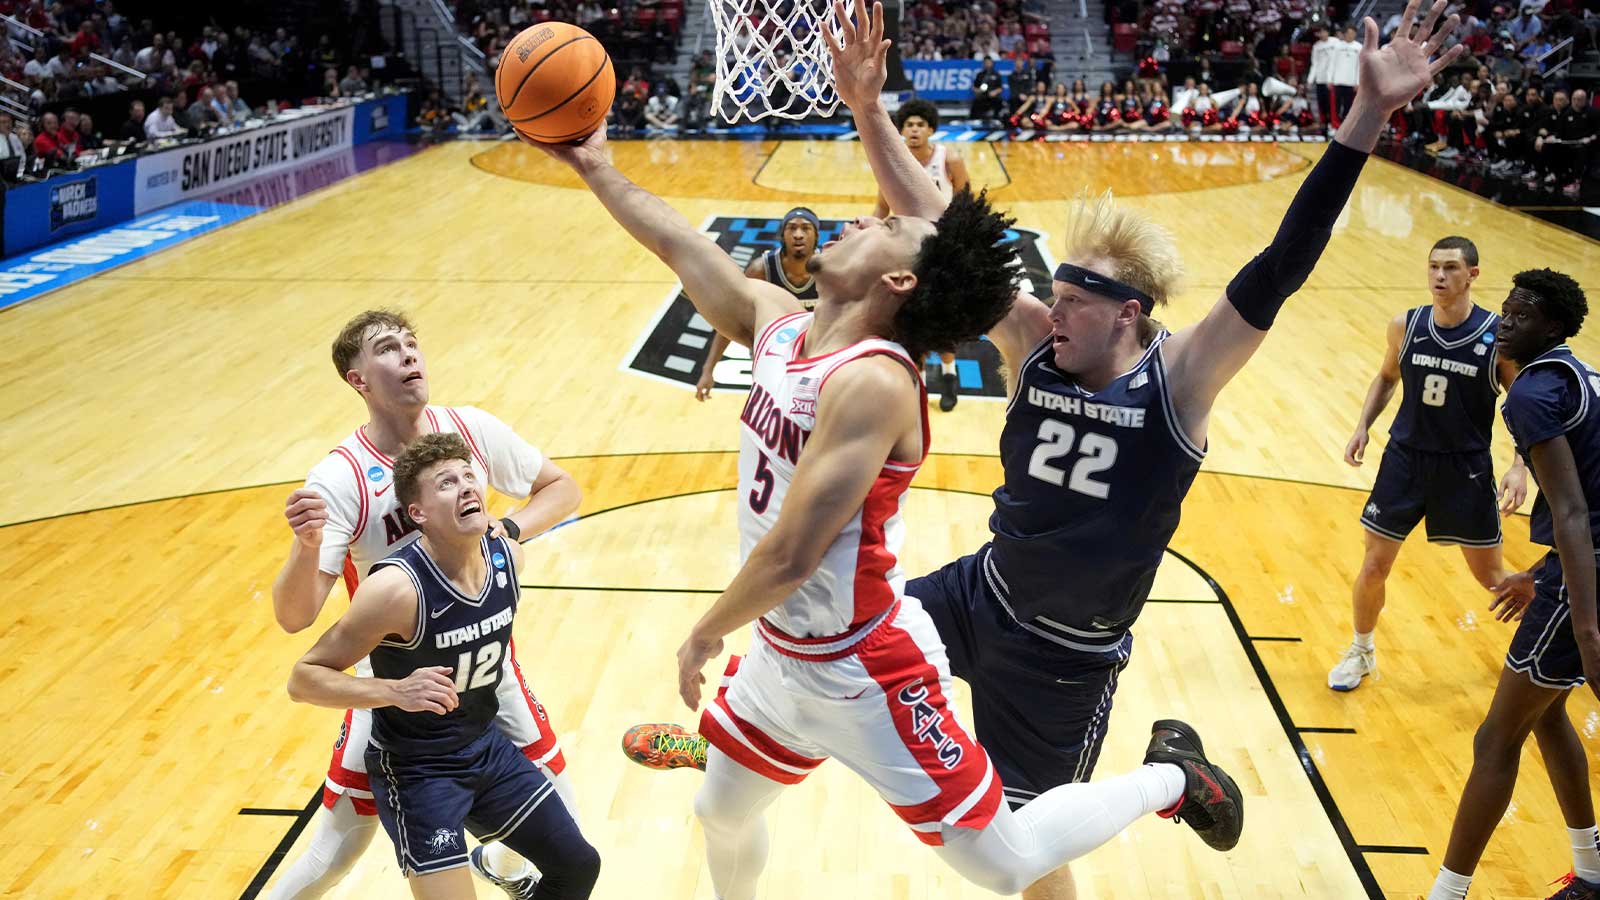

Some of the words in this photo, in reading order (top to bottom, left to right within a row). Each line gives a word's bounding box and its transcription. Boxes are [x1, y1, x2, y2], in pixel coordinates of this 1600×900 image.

[181, 149, 212, 191] SAN
[213, 140, 250, 182] DIEGO
[253, 130, 288, 169] STATE
[291, 115, 347, 159] UNIVERSITY
[1412, 353, 1441, 368] UTAH
[1441, 358, 1478, 377] STATE
[1422, 374, 1448, 407] 8
[740, 382, 812, 466] RIZON
[1028, 386, 1082, 415] UTAH
[1083, 401, 1147, 428] STATE
[749, 449, 775, 515] 5
[1028, 418, 1118, 499] 22
[435, 623, 480, 649] UTAH
[480, 606, 513, 636] STATE
[455, 641, 502, 693] 12
[898, 677, 963, 770] CATS
